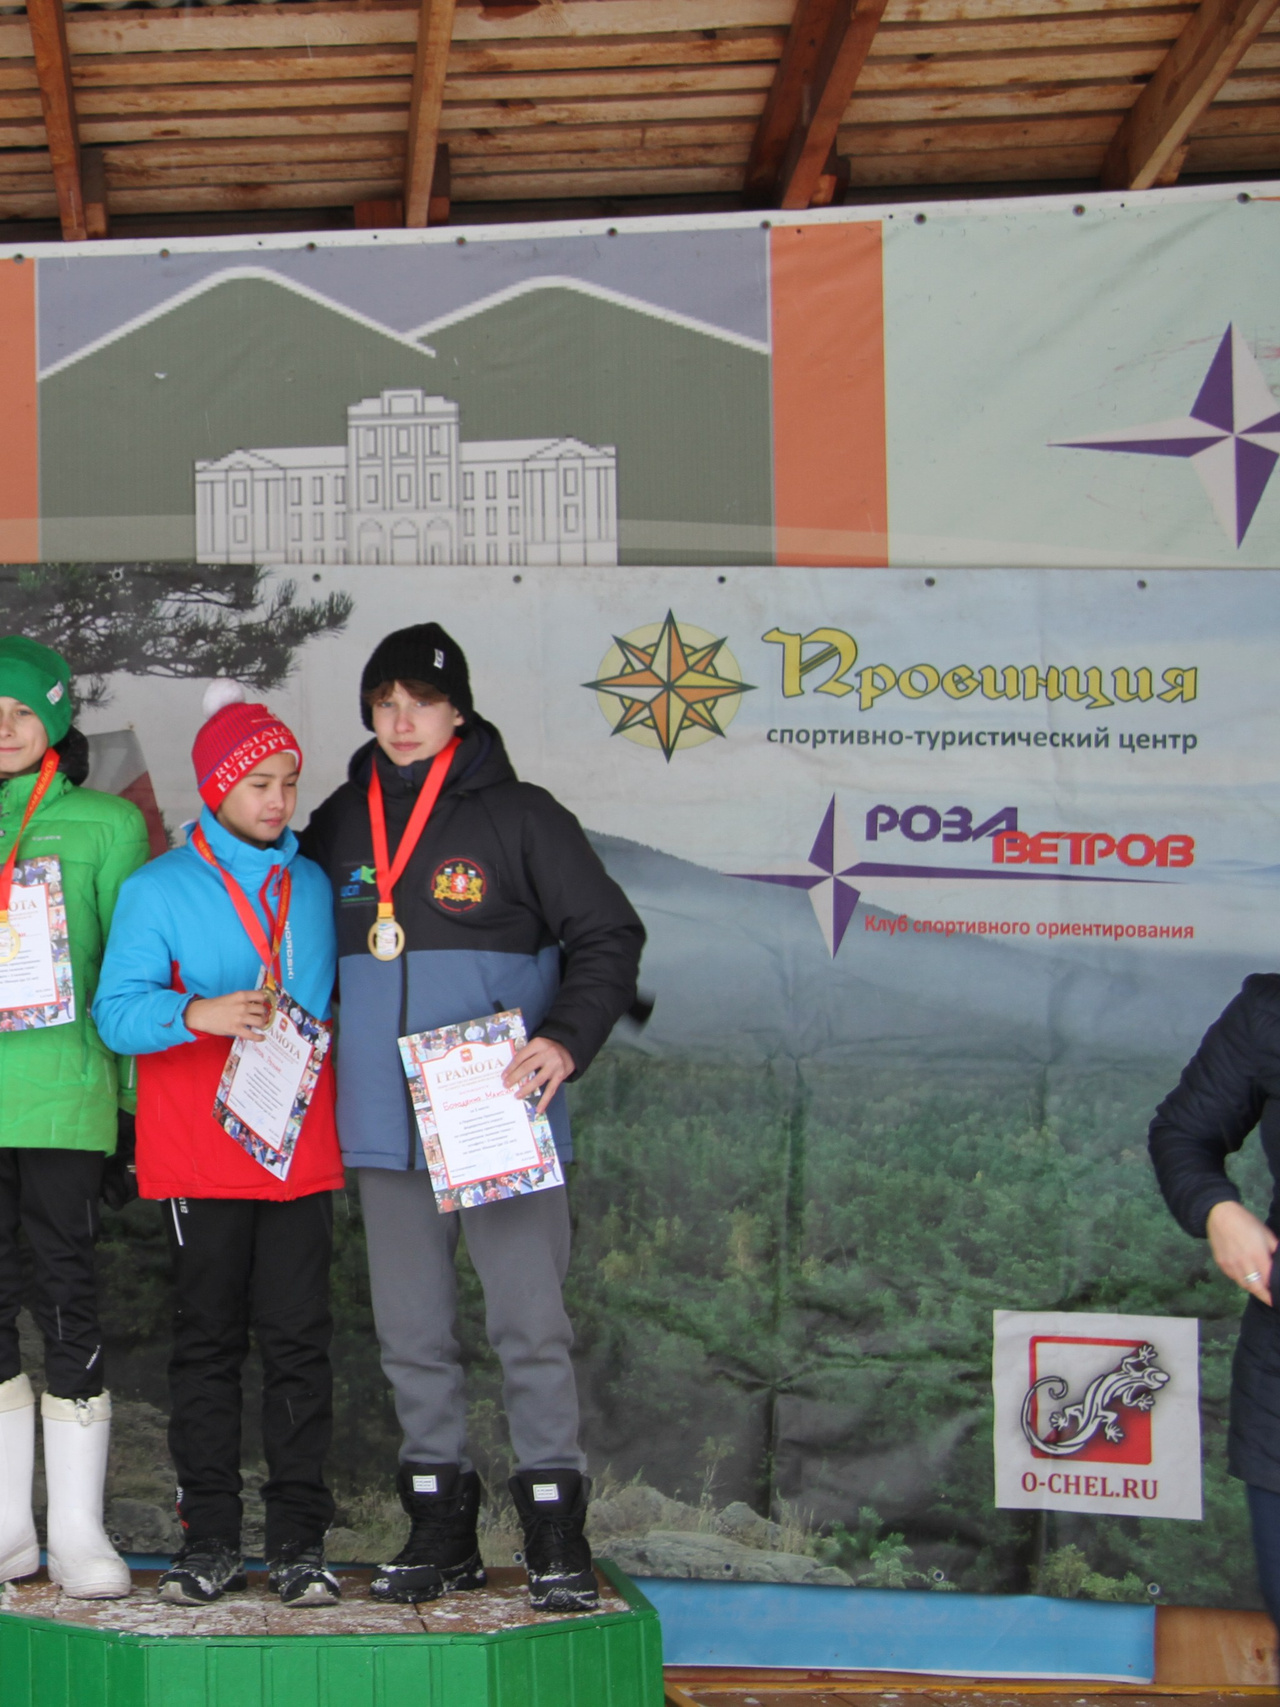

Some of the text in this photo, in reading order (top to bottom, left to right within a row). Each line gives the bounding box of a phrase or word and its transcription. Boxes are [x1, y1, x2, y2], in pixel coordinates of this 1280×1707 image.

[761, 626, 1199, 711] Провинция
[766, 725, 1198, 754] спортивно-туристический центр
[865, 803, 1021, 843] РОЗА
[992, 830, 1195, 868] ВЕТРОВ
[864, 914, 1195, 941] Клуб спортивного ориентирования
[284, 920, 294, 980] NORDSKI
[436, 1057, 505, 1084] ГРАМОТА
[1021, 1472, 1158, 1500] O-CHEL.RU
